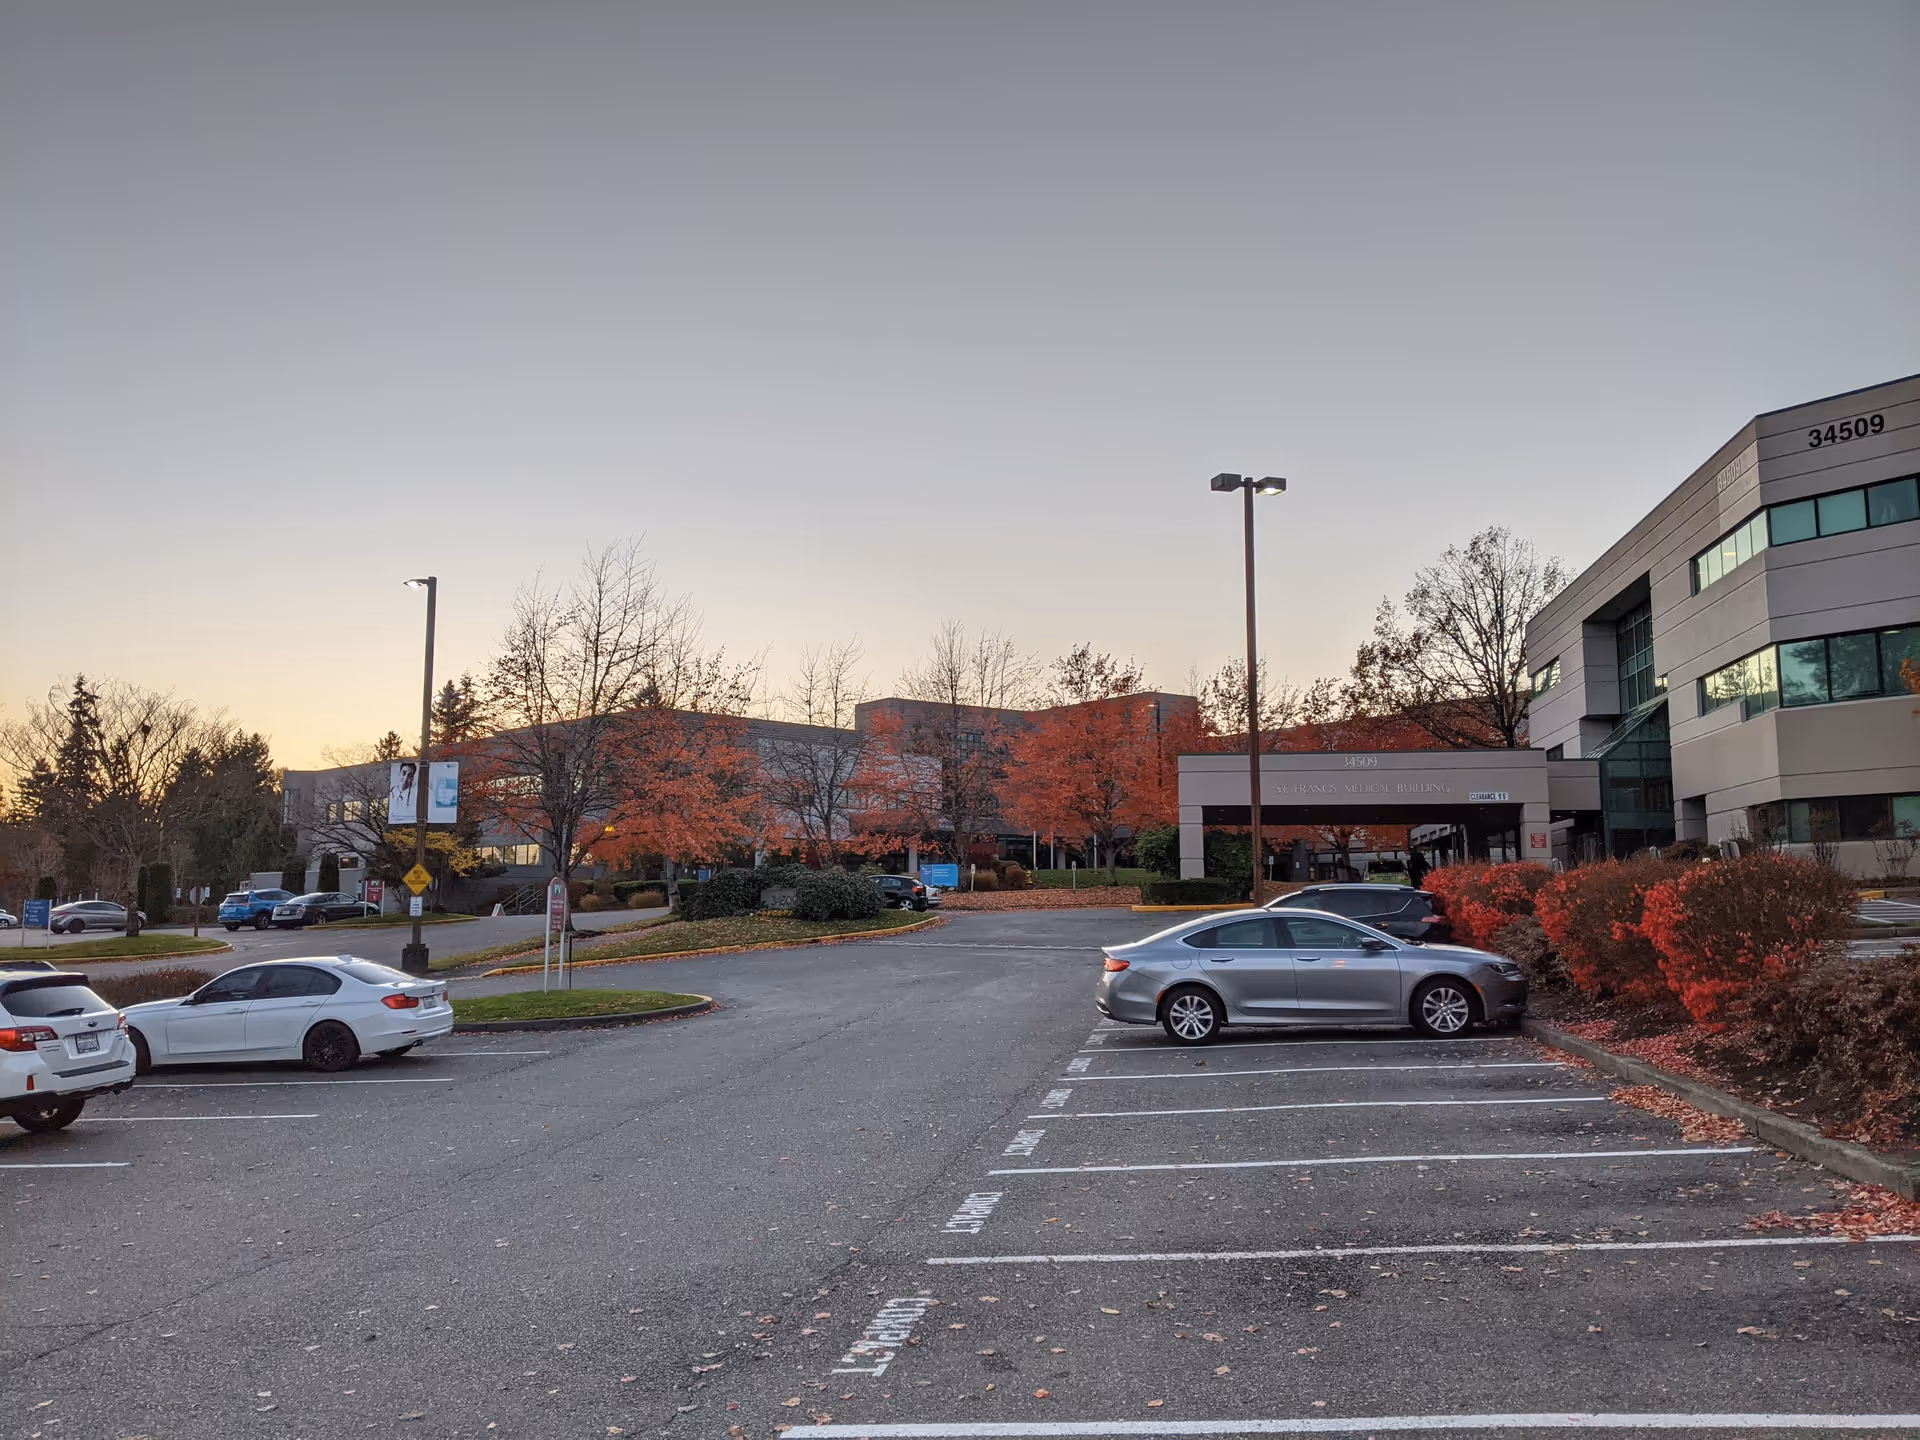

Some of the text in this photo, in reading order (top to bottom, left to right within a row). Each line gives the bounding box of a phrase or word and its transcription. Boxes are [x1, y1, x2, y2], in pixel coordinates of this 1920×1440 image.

[1808, 414, 1885, 448] 34509
[1344, 756, 1378, 768] 34509
[1294, 783, 1337, 793] FRANCIS
[1344, 783, 1391, 793] MEDICAL
[1397, 783, 1451, 793] BUILDING
[1470, 792, 1496, 801] CLEARANCE
[941, 1192, 1003, 1234] COMPACT
[831, 1298, 933, 1377] COMPACT
